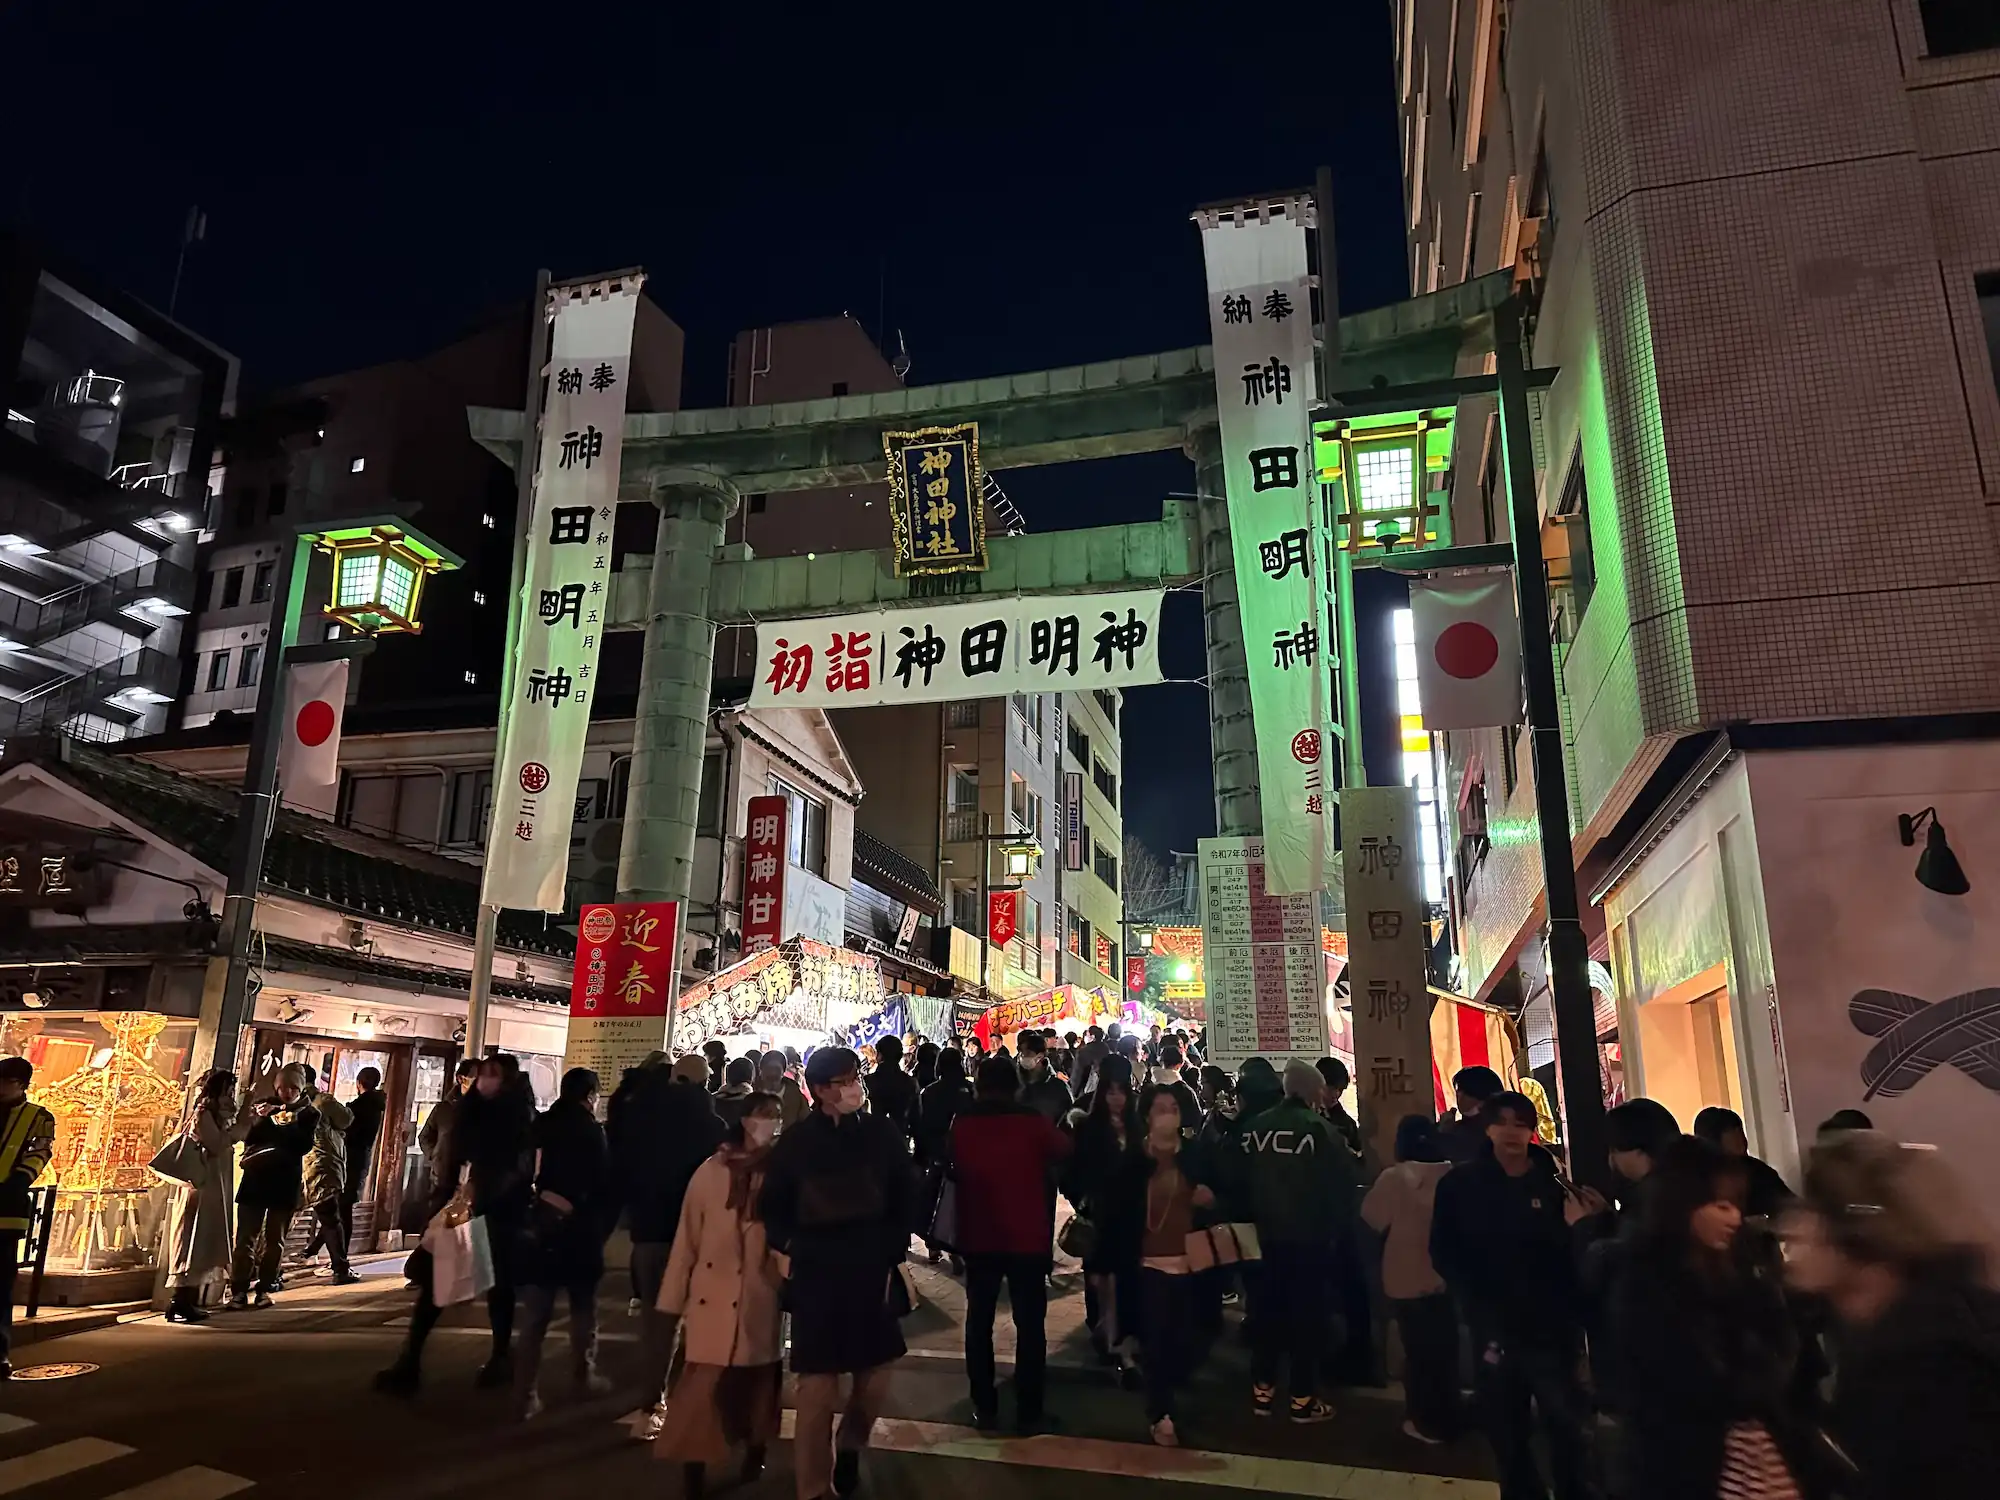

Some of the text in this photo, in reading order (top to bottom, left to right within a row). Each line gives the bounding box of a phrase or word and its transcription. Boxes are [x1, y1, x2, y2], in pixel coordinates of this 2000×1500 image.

[1222, 289, 1294, 324] 奉納
[557, 363, 616, 394] 奉納
[918, 446, 959, 556] 神田神社
[1241, 356, 1317, 670] 神田明神
[526, 425, 602, 708] 神田明神
[574, 506, 611, 703] 令和五年五月吉日
[764, 608, 1148, 695] 初詣 神田明神
[1304, 768, 1323, 815] 三越
[515, 798, 536, 841] 三越
[1069, 800, 1078, 841] TAIMEI
[744, 815, 780, 953] 明神甘酒
[993, 898, 1011, 935] 迎春
[1210, 885, 1221, 935] 男の厄年
[614, 909, 660, 1004] 迎春
[1130, 962, 1143, 986] 迎春
[1289, 946, 1310, 955] 後厄
[1358, 835, 1415, 1100] 神田神社
[585, 961, 603, 1011] 神田明神
[1214, 979, 1225, 1028] 女の厄年
[261, 1048, 282, 1077] か
